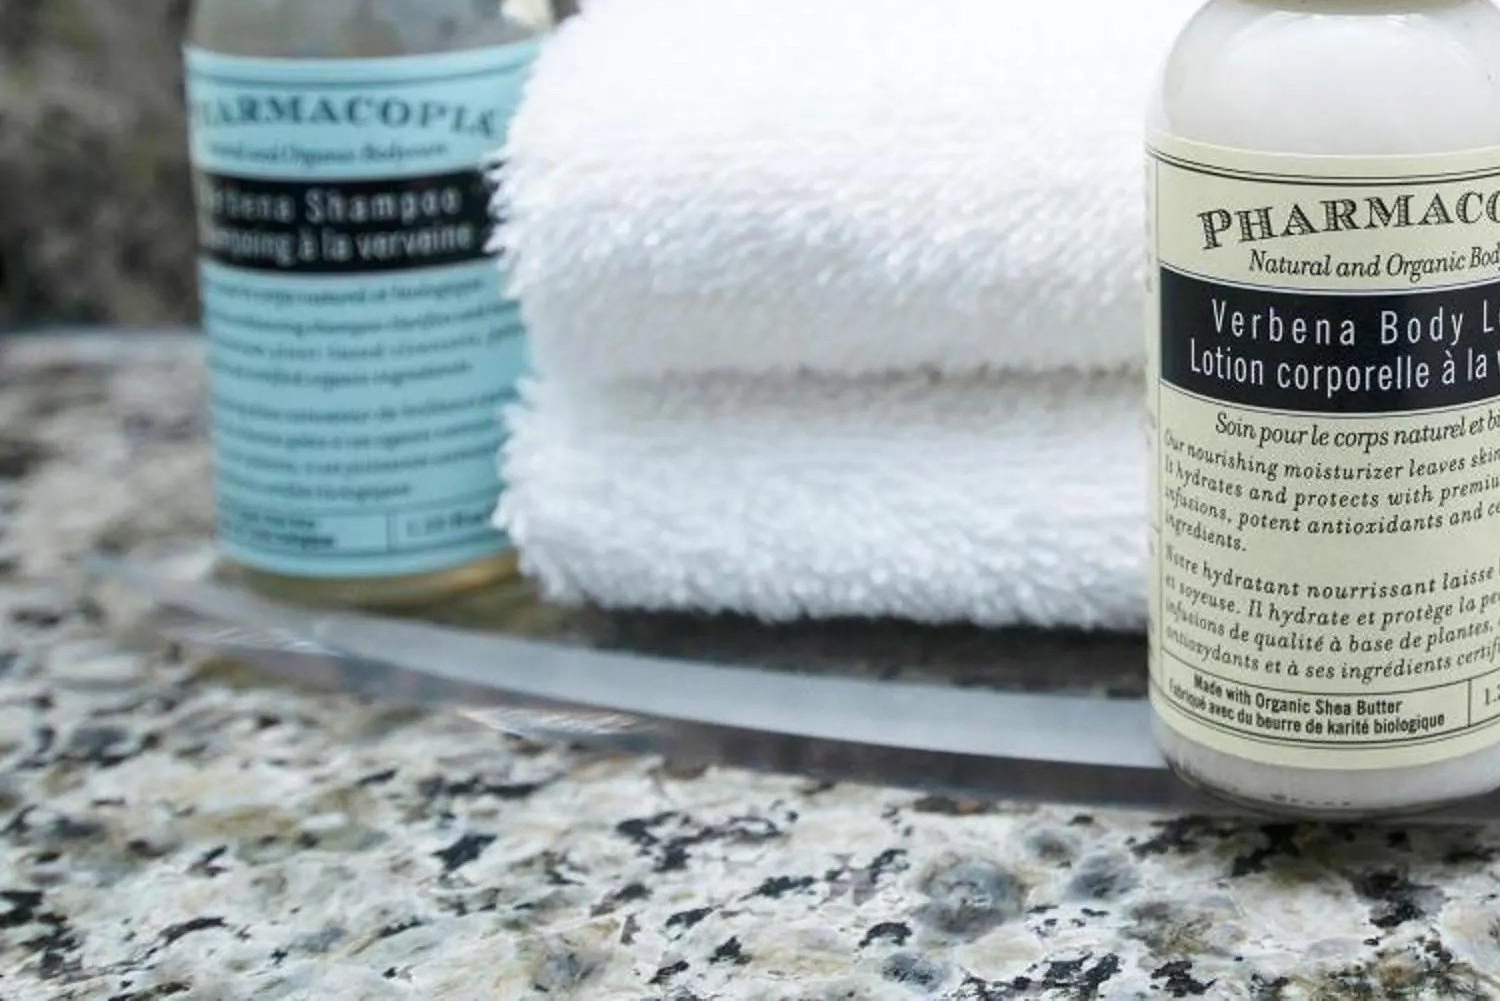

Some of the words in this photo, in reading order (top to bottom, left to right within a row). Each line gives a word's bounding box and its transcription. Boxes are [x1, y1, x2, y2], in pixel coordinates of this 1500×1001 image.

[204, 95, 496, 137] ARMACOPIA
[1248, 248, 1331, 276] Natural
[1336, 254, 1381, 277] and
[1386, 250, 1466, 283] Organic
[1212, 298, 1355, 346] Verbena
[1381, 310, 1464, 346] Body
[1190, 337, 1264, 386] Lotion
[1277, 355, 1430, 398] corporelle
[1441, 349, 1456, 384] à
[1466, 346, 1487, 381] la
[1215, 411, 1256, 440] Soin
[1258, 424, 1308, 449] pour
[1311, 423, 1329, 446] le
[1334, 430, 1389, 453] corps
[1393, 415, 1466, 446] naturel
[1469, 416, 1484, 435] et
[1187, 441, 1279, 482] nourishing
[1284, 462, 1403, 481] moisturizer
[1409, 453, 1466, 479] leaves
[1176, 459, 1243, 498] hydrates
[1249, 486, 1287, 504] and
[1293, 488, 1379, 511] protects
[1388, 479, 1433, 506] with
[1165, 509, 1247, 552] ingredients.
[1237, 510, 1301, 532] potent
[1307, 513, 1443, 535] antioxidants
[1449, 500, 1483, 526] and
[1165, 543, 1198, 576] Notre
[1202, 559, 1300, 598] hydratant
[1307, 576, 1436, 599] nourrissant
[1442, 565, 1494, 591] laisse
[1179, 581, 1242, 615] soyeuse.
[1248, 598, 1263, 619] Il
[1268, 601, 1350, 629] hydrate
[1356, 607, 1376, 626] et
[1381, 600, 1453, 631] protège
[1459, 595, 1475, 613] la
[1229, 622, 1249, 644] de
[1253, 630, 1324, 653] qualité
[1330, 634, 1342, 653] à
[1349, 631, 1393, 653] base
[1399, 626, 1423, 650] de
[1265, 659, 1281, 675] et
[1287, 659, 1299, 676] à
[1305, 665, 1334, 680] ses
[1340, 654, 1451, 685] ingrédients
[1193, 674, 1223, 699] Made
[1226, 687, 1251, 707] with
[1255, 693, 1311, 716] Organic
[1315, 697, 1350, 717] Shea
[1356, 700, 1403, 718] Butter
[1208, 700, 1235, 721] avec
[1237, 708, 1253, 727] du
[1255, 713, 1302, 734] beurre
[1305, 716, 1324, 735] de
[1327, 717, 1370, 736] karité
[1373, 711, 1446, 738] biologique
